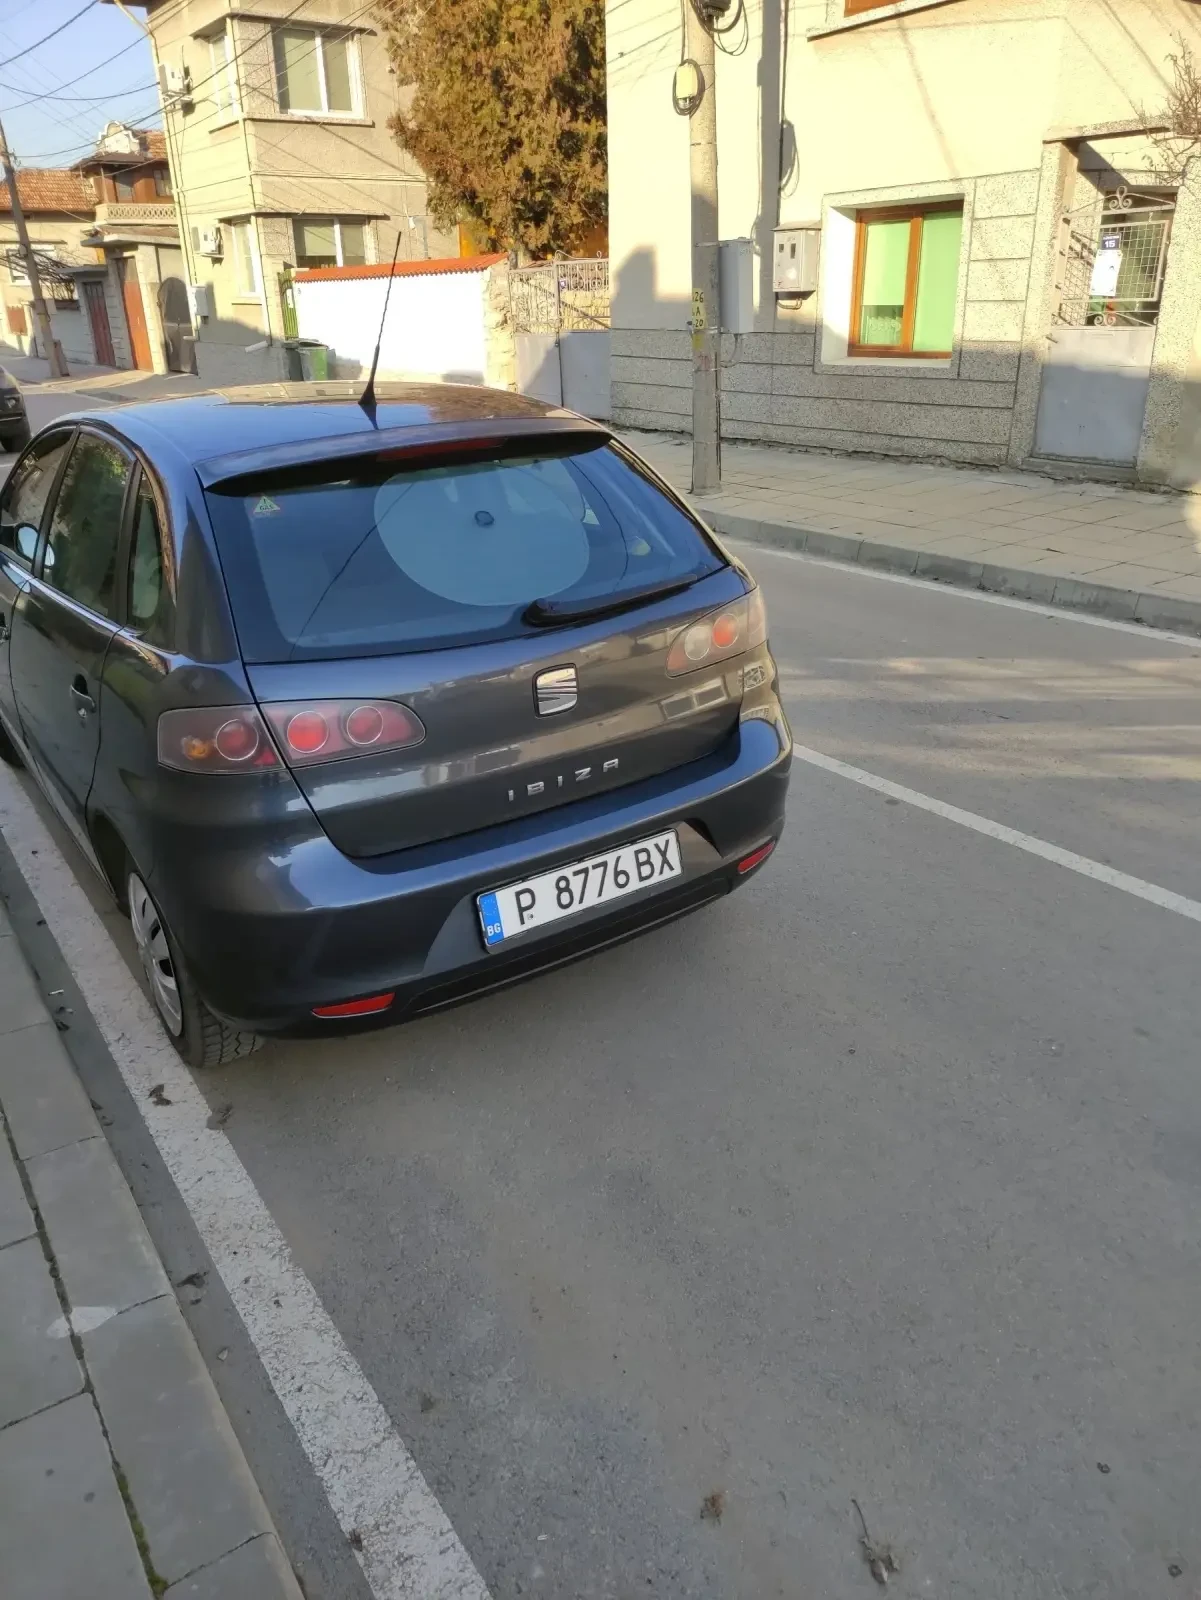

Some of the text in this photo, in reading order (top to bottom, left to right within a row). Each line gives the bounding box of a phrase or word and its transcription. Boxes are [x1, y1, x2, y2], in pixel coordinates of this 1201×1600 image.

[1104, 239, 1116, 249] 15
[508, 758, 619, 801] IBIZA
[514, 839, 675, 926] P 8776 BX
[486, 923, 502, 937] BG
